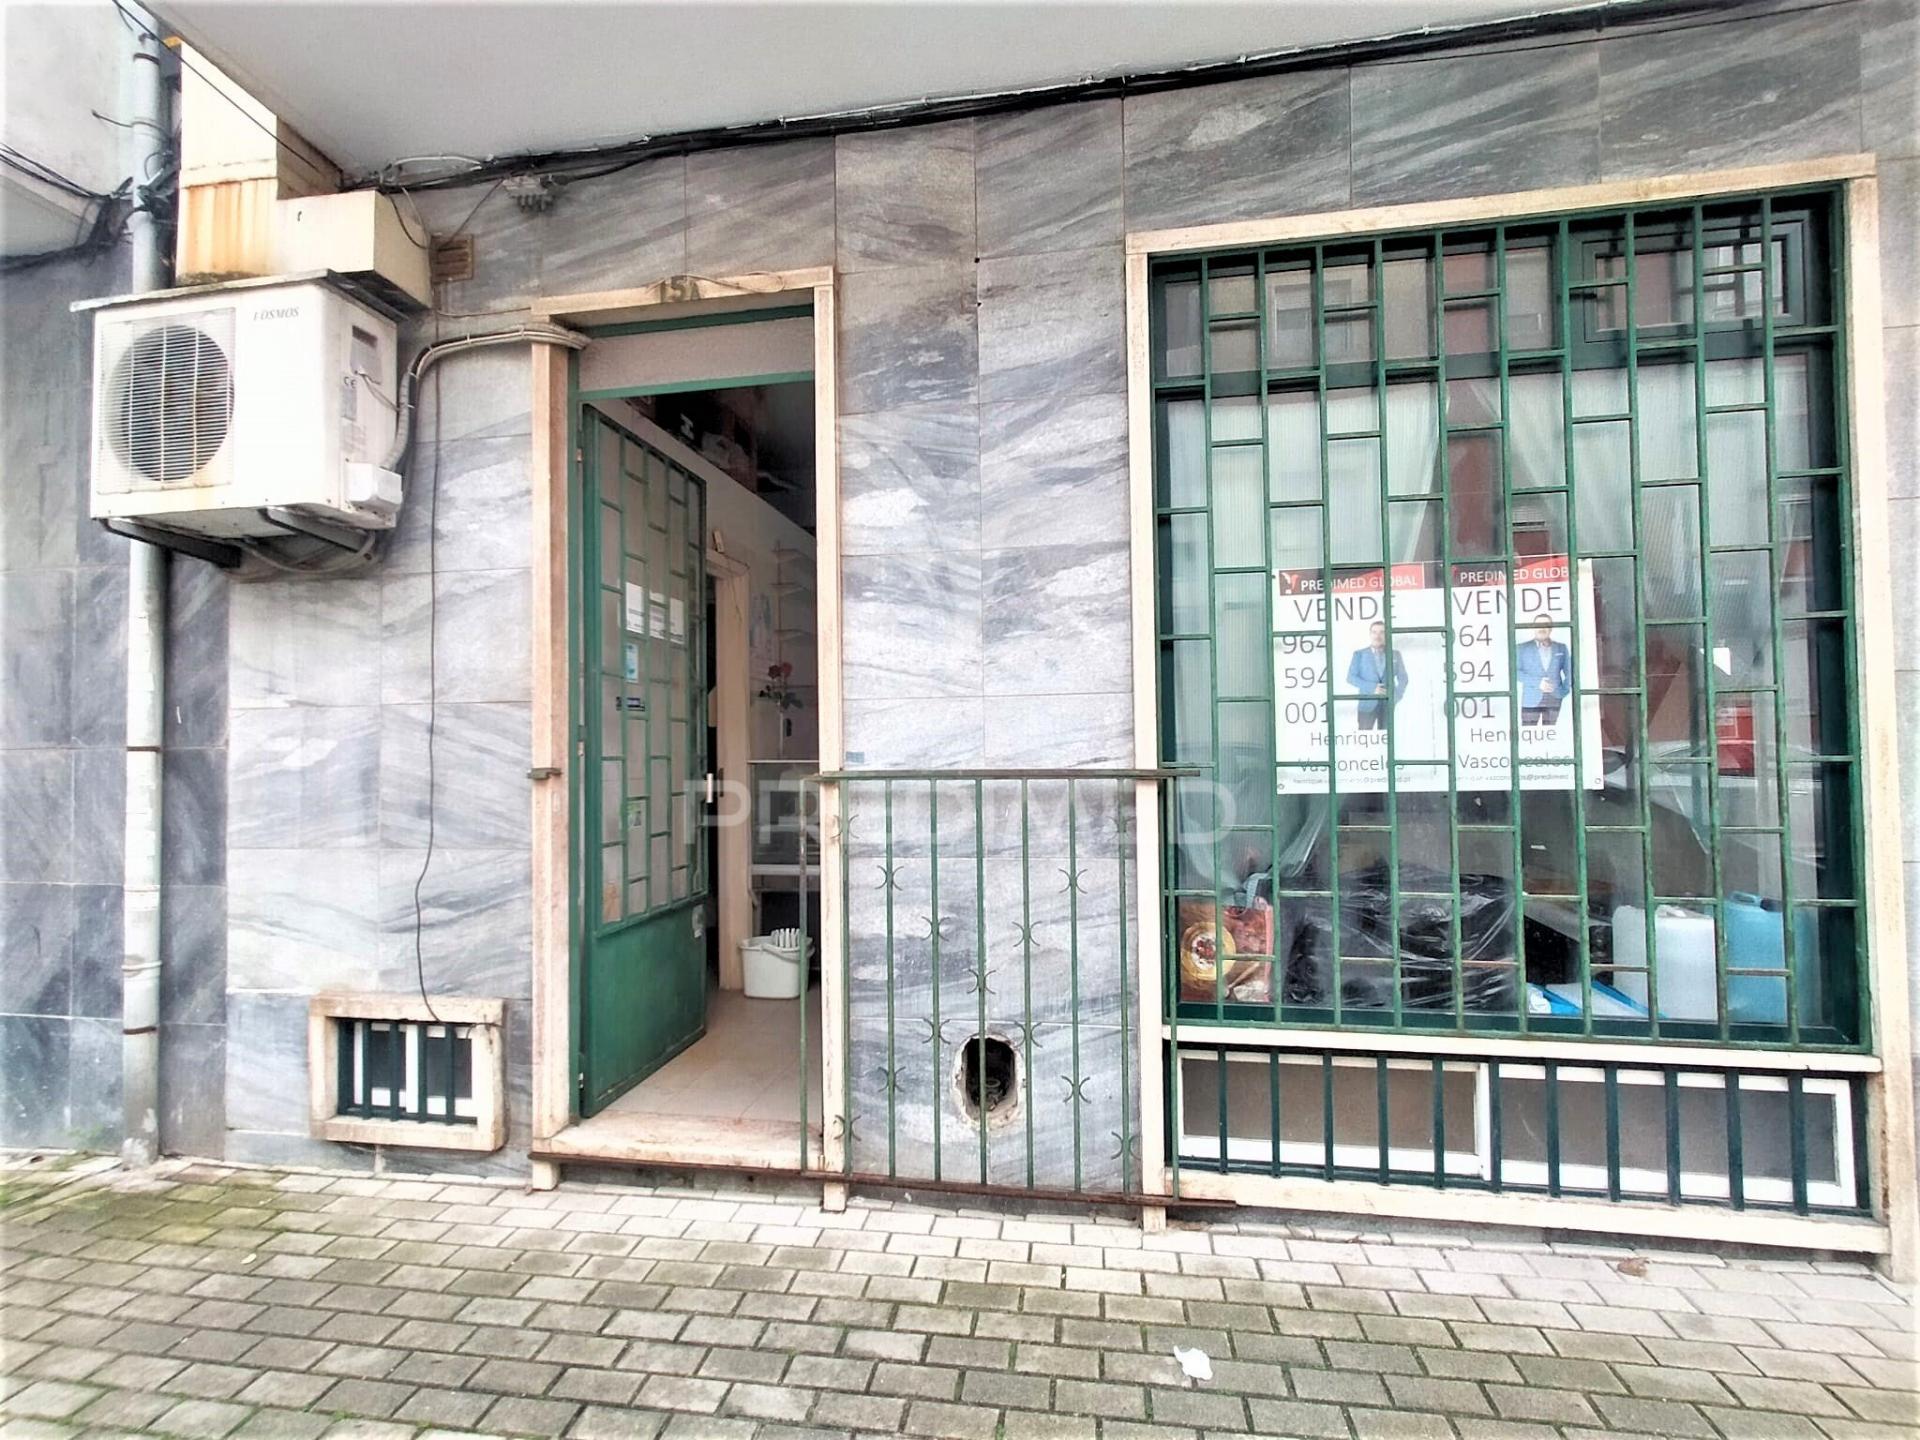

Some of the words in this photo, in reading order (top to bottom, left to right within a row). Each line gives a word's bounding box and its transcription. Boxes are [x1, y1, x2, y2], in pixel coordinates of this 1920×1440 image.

[1300, 578, 1366, 592] PREIMED
[1453, 586, 1562, 616] VENDE
[1470, 727, 1557, 745] Henque
[1458, 752, 1572, 768] Vascocelos
